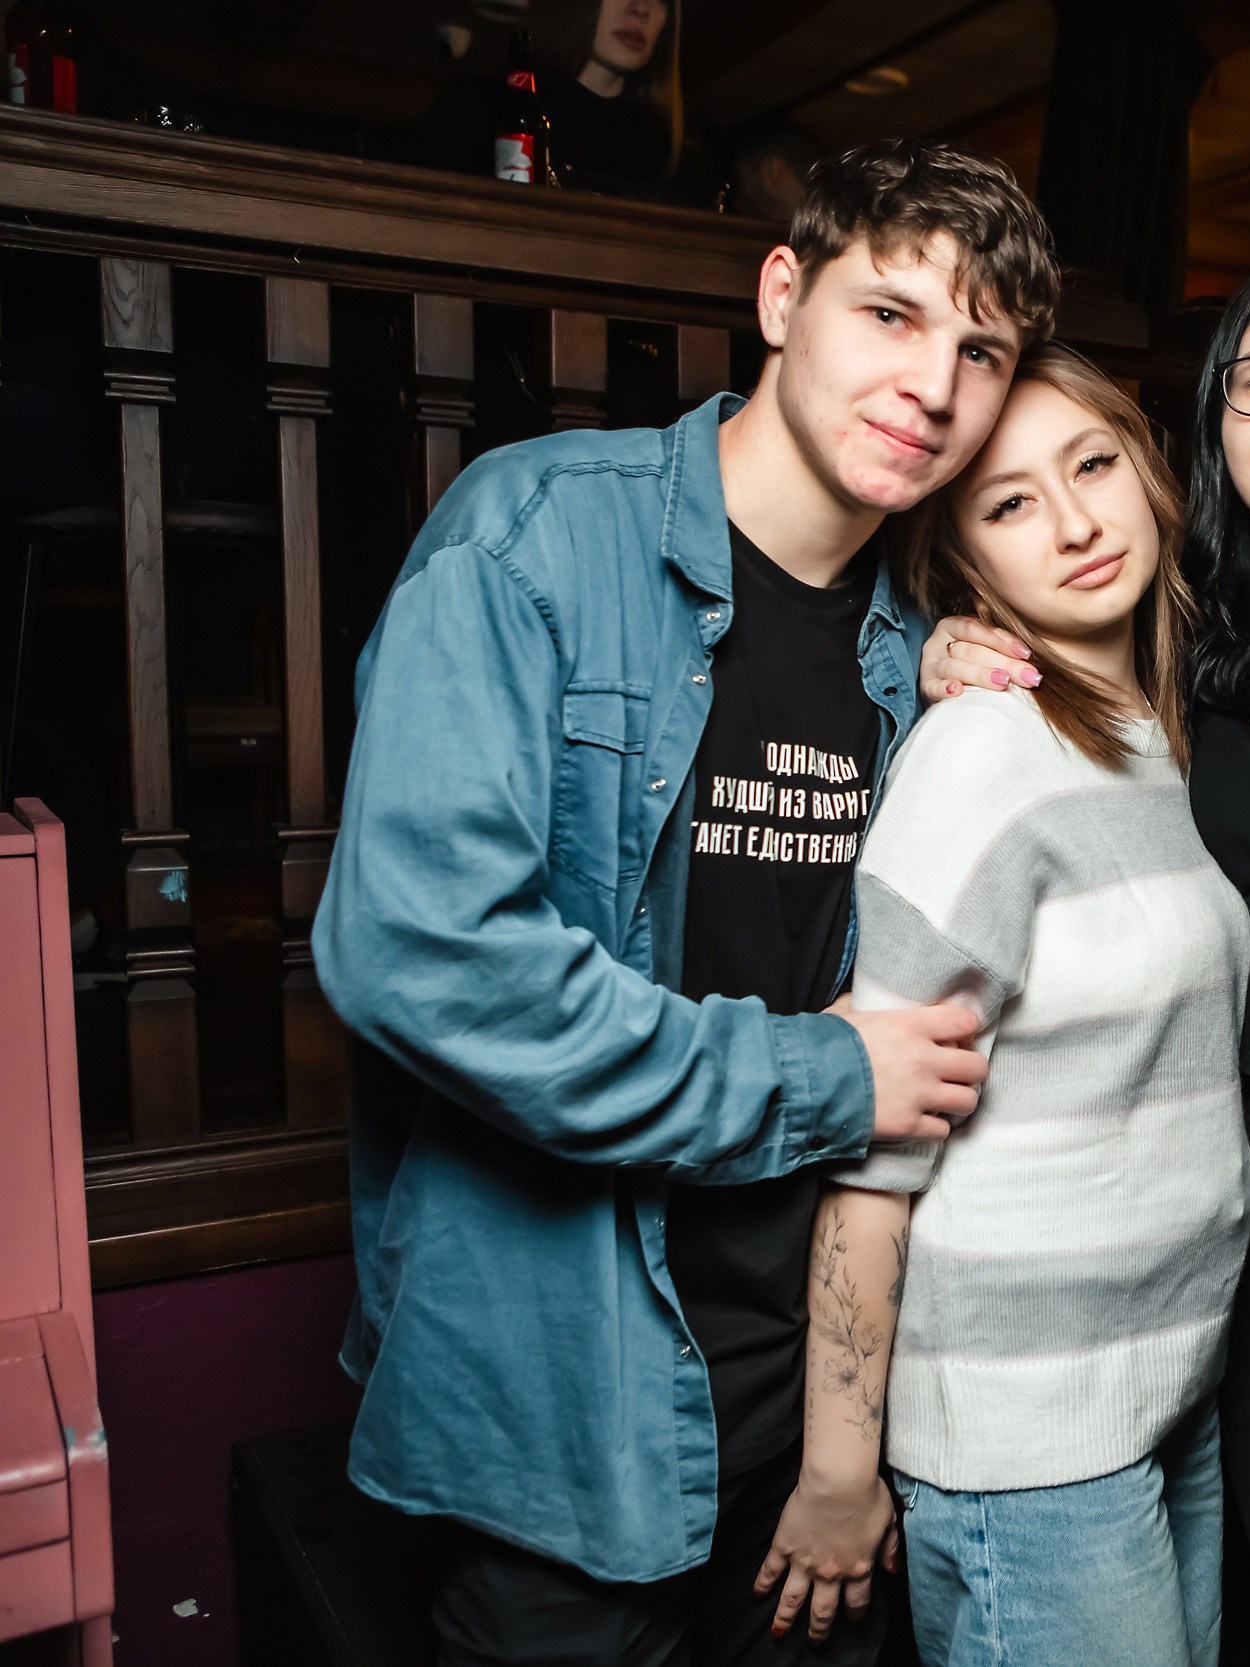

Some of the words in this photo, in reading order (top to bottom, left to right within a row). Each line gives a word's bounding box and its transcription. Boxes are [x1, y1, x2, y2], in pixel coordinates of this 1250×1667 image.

[767, 742, 860, 784] ОДНАЖДЫ
[778, 788, 806, 819] ИЗ
[690, 821, 743, 855] АНЕТ
